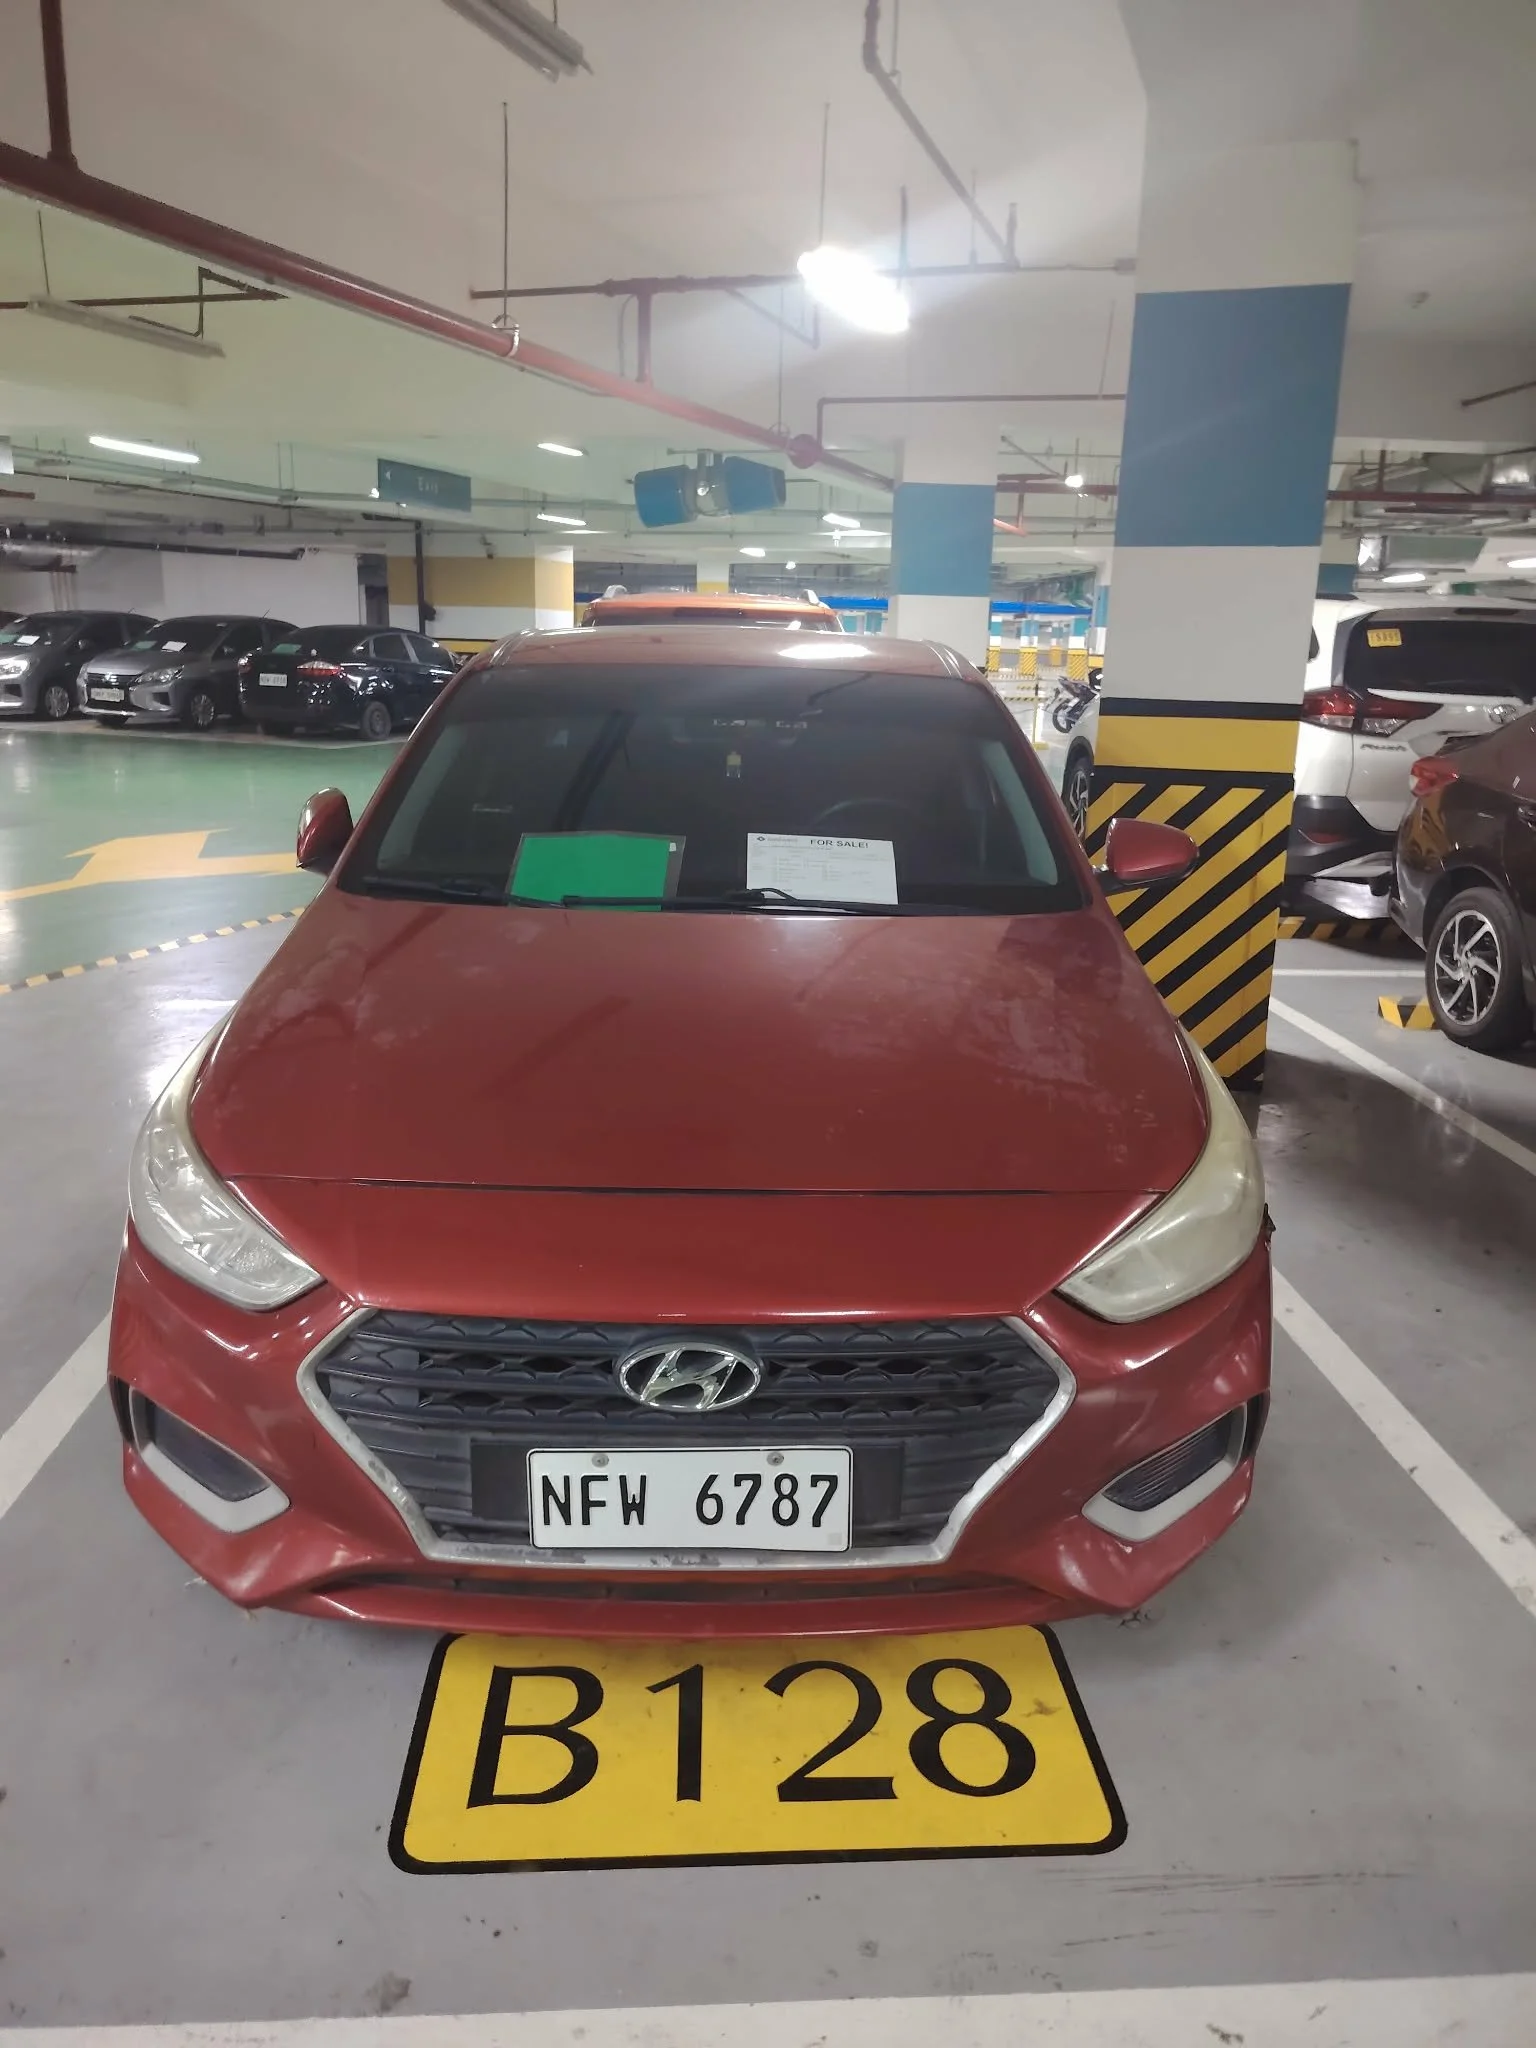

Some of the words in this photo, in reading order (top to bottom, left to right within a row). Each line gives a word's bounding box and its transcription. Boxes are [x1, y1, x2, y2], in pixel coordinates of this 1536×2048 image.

[836, 840, 869, 848] SALE!
[541, 1474, 647, 1526] NFW
[695, 1473, 839, 1528] 6787
[466, 1657, 1037, 1810] B128
